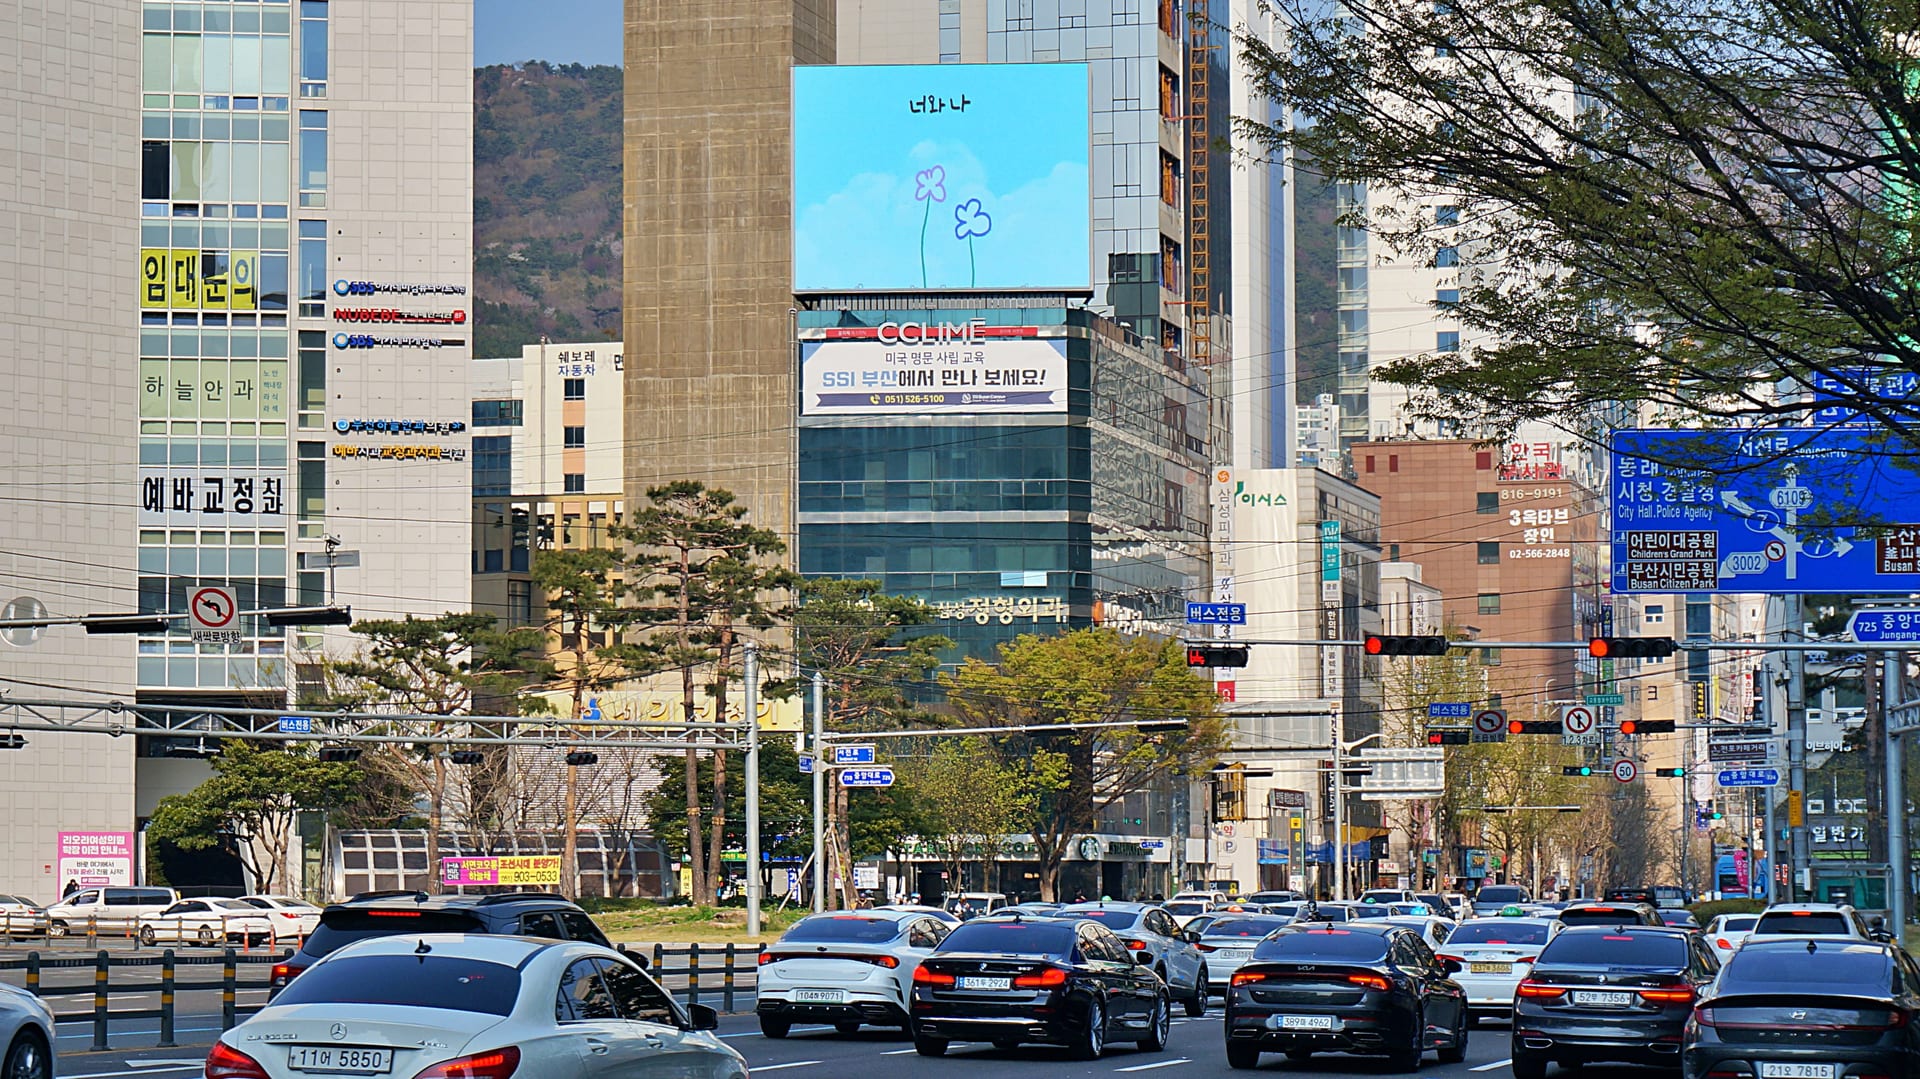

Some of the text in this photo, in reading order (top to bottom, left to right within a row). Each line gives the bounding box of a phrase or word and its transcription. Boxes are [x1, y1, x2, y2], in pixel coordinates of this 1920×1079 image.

[335, 307, 400, 322] NUBEBE
[558, 350, 595, 363] 쉐보레
[885, 351, 985, 365] 미국 명문 사립 교육
[558, 364, 595, 376] 자동차
[822, 368, 1047, 388] SSI 부산에서 만나 보세요!
[144, 375, 254, 401] 하늘안과
[905, 394, 945, 404] 526-5100
[1618, 457, 1659, 478] 동래
[143, 476, 284, 514] 예바교정치과
[1501, 488, 1562, 499] 816-9191
[1509, 508, 1569, 526] 3옥타브
[1618, 504, 1634, 521] City
[1684, 505, 1713, 521] Agency
[1218, 488, 1232, 566] 삼성피부과
[1757, 514, 1768, 529] 7
[1523, 527, 1555, 544] 장인
[1630, 532, 1715, 549] 어린이대공원
[1883, 527, 1920, 546] 부산
[1509, 549, 1570, 559] 02-566-2848
[1631, 549, 1714, 559] Children's Grand Park
[1732, 556, 1761, 571] 3002
[1884, 560, 1913, 572] Busan
[1630, 563, 1715, 579] 부산시민공원
[1630, 578, 1715, 590] Busan Citizen Park
[1190, 606, 1241, 621] 버스전용
[1858, 621, 1878, 632] 725
[193, 631, 240, 644] 새싹로방향
[1431, 703, 1469, 716] 버스전용
[281, 719, 309, 730] 버스전용
[1619, 765, 1632, 777] 50
[1223, 825, 1233, 836] 약
[514, 871, 558, 882] 903-0533
[988, 978, 1009, 988] 2924
[820, 992, 839, 1000] 9071
[1601, 993, 1626, 1003] 7356
[1307, 1018, 1330, 1027] 4962
[300, 1048, 383, 1069] 11어 5850
[1769, 1064, 1828, 1077] 21오 7815
